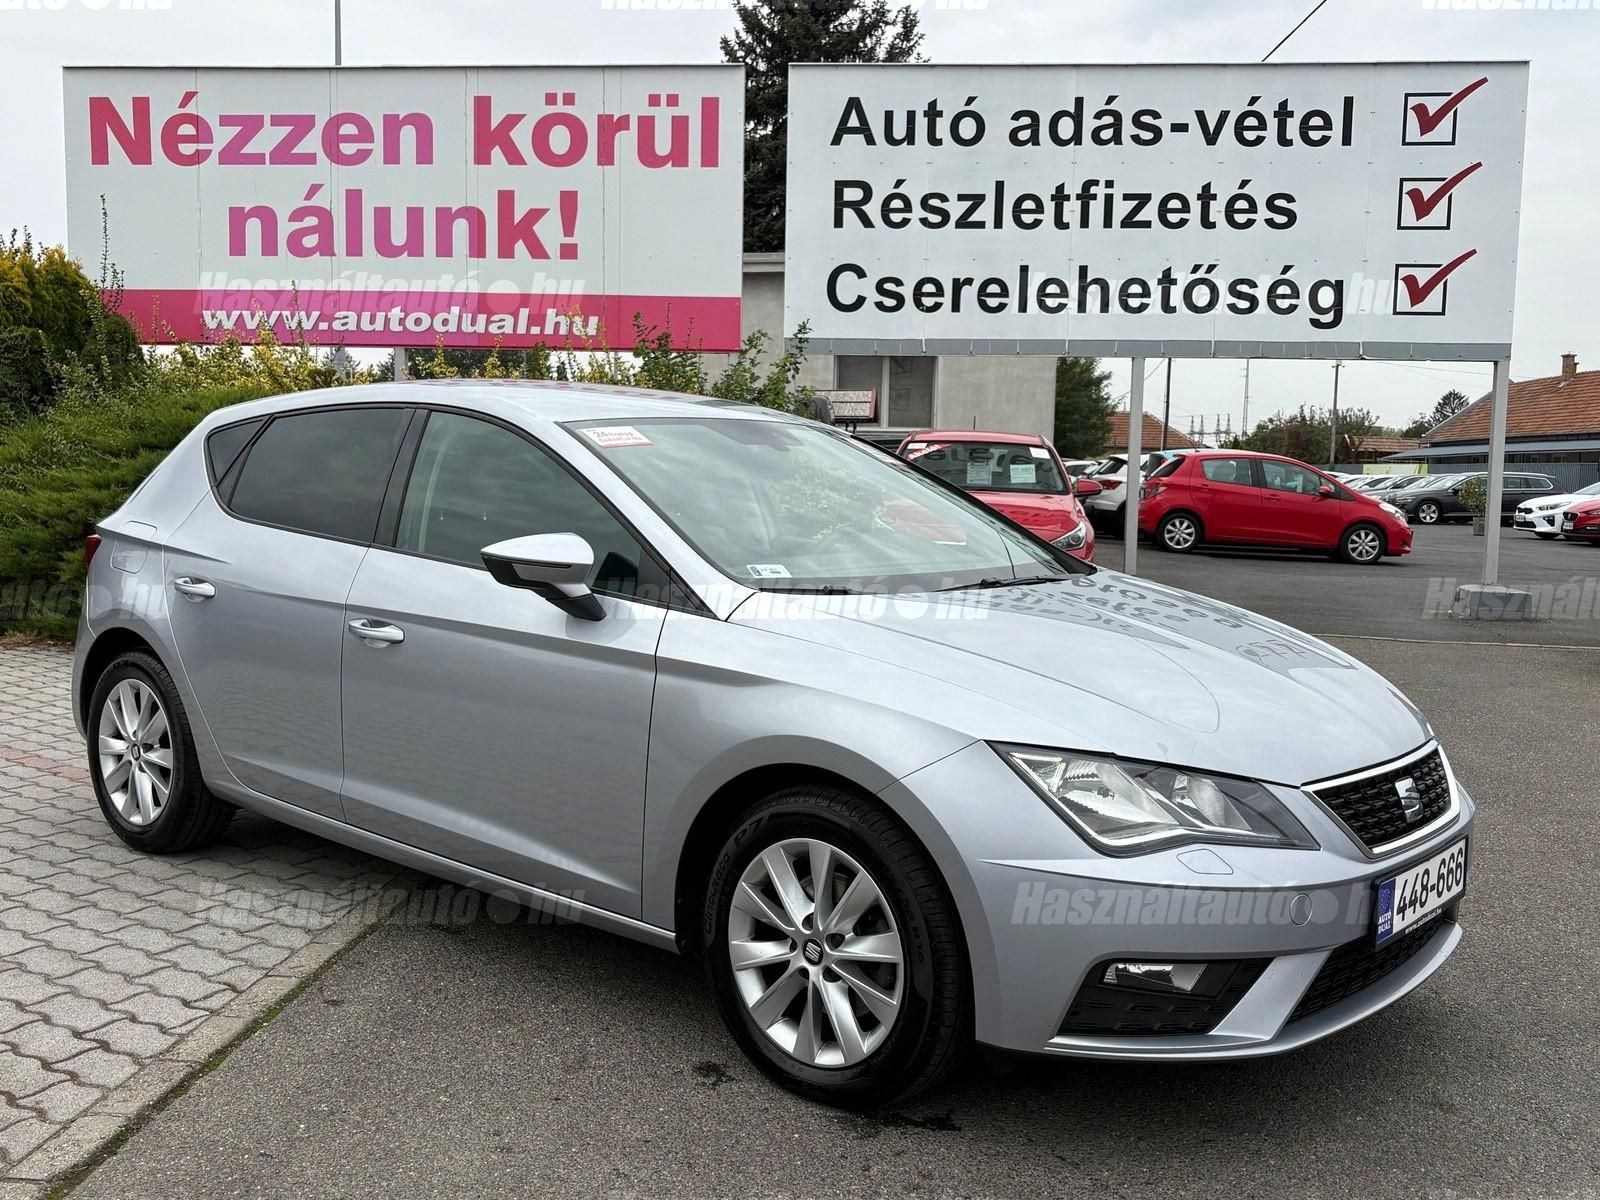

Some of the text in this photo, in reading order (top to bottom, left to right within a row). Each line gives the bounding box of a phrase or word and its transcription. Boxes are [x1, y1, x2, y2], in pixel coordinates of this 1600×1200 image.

[89, 90, 720, 169] Nézzen körül
[829, 94, 1355, 149] Autó adás-vétel
[228, 184, 579, 261] nálunk!
[832, 177, 1299, 232] Részletfizetés
[202, 305, 602, 337] www.autodual.hu
[825, 261, 1345, 331] Cserelehetőség
[1395, 846, 1465, 922] 448-666
